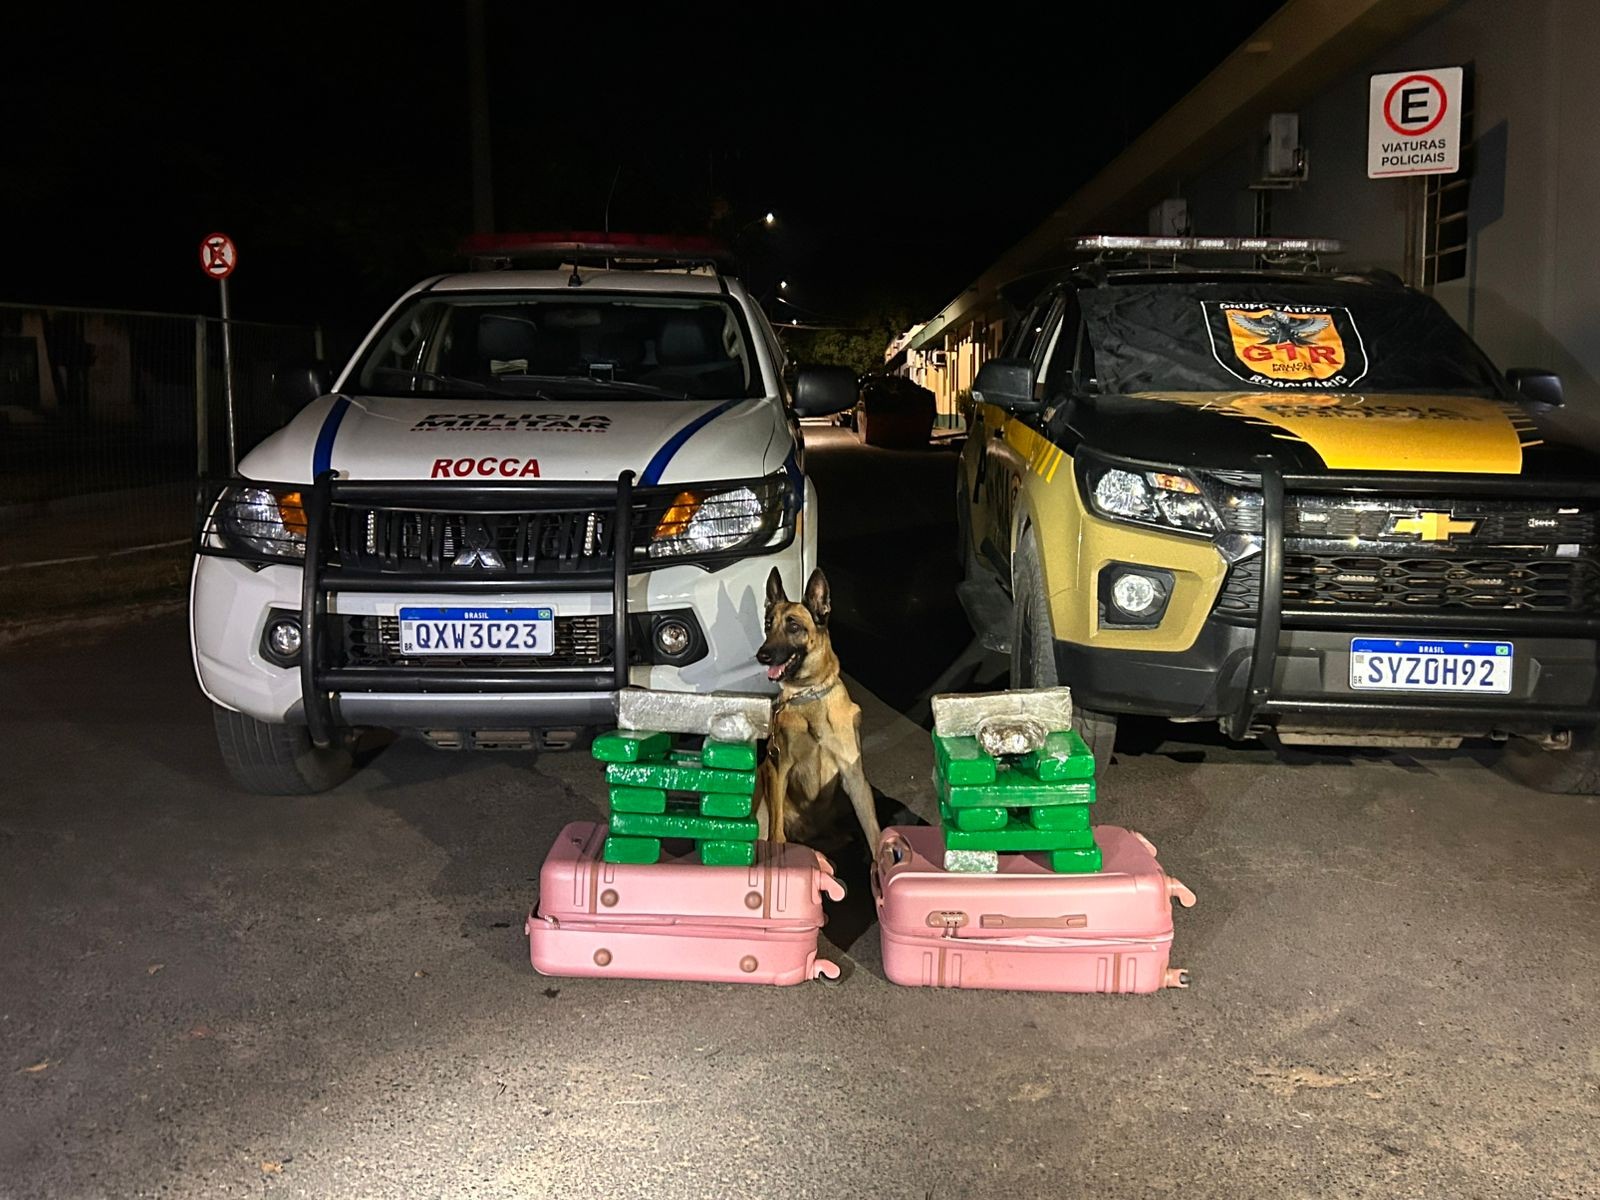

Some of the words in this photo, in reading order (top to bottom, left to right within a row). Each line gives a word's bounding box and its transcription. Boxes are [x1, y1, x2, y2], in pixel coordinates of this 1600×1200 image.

[1401, 87, 1429, 124] E
[1382, 139, 1446, 153] VIATURAS
[1381, 152, 1445, 166] POLICIAIS
[1242, 341, 1341, 365] GTR
[415, 420, 611, 429] MILITAR
[431, 457, 541, 478] ROCCA
[416, 623, 537, 649] QXW3C23
[1418, 646, 1445, 654] BRASIL
